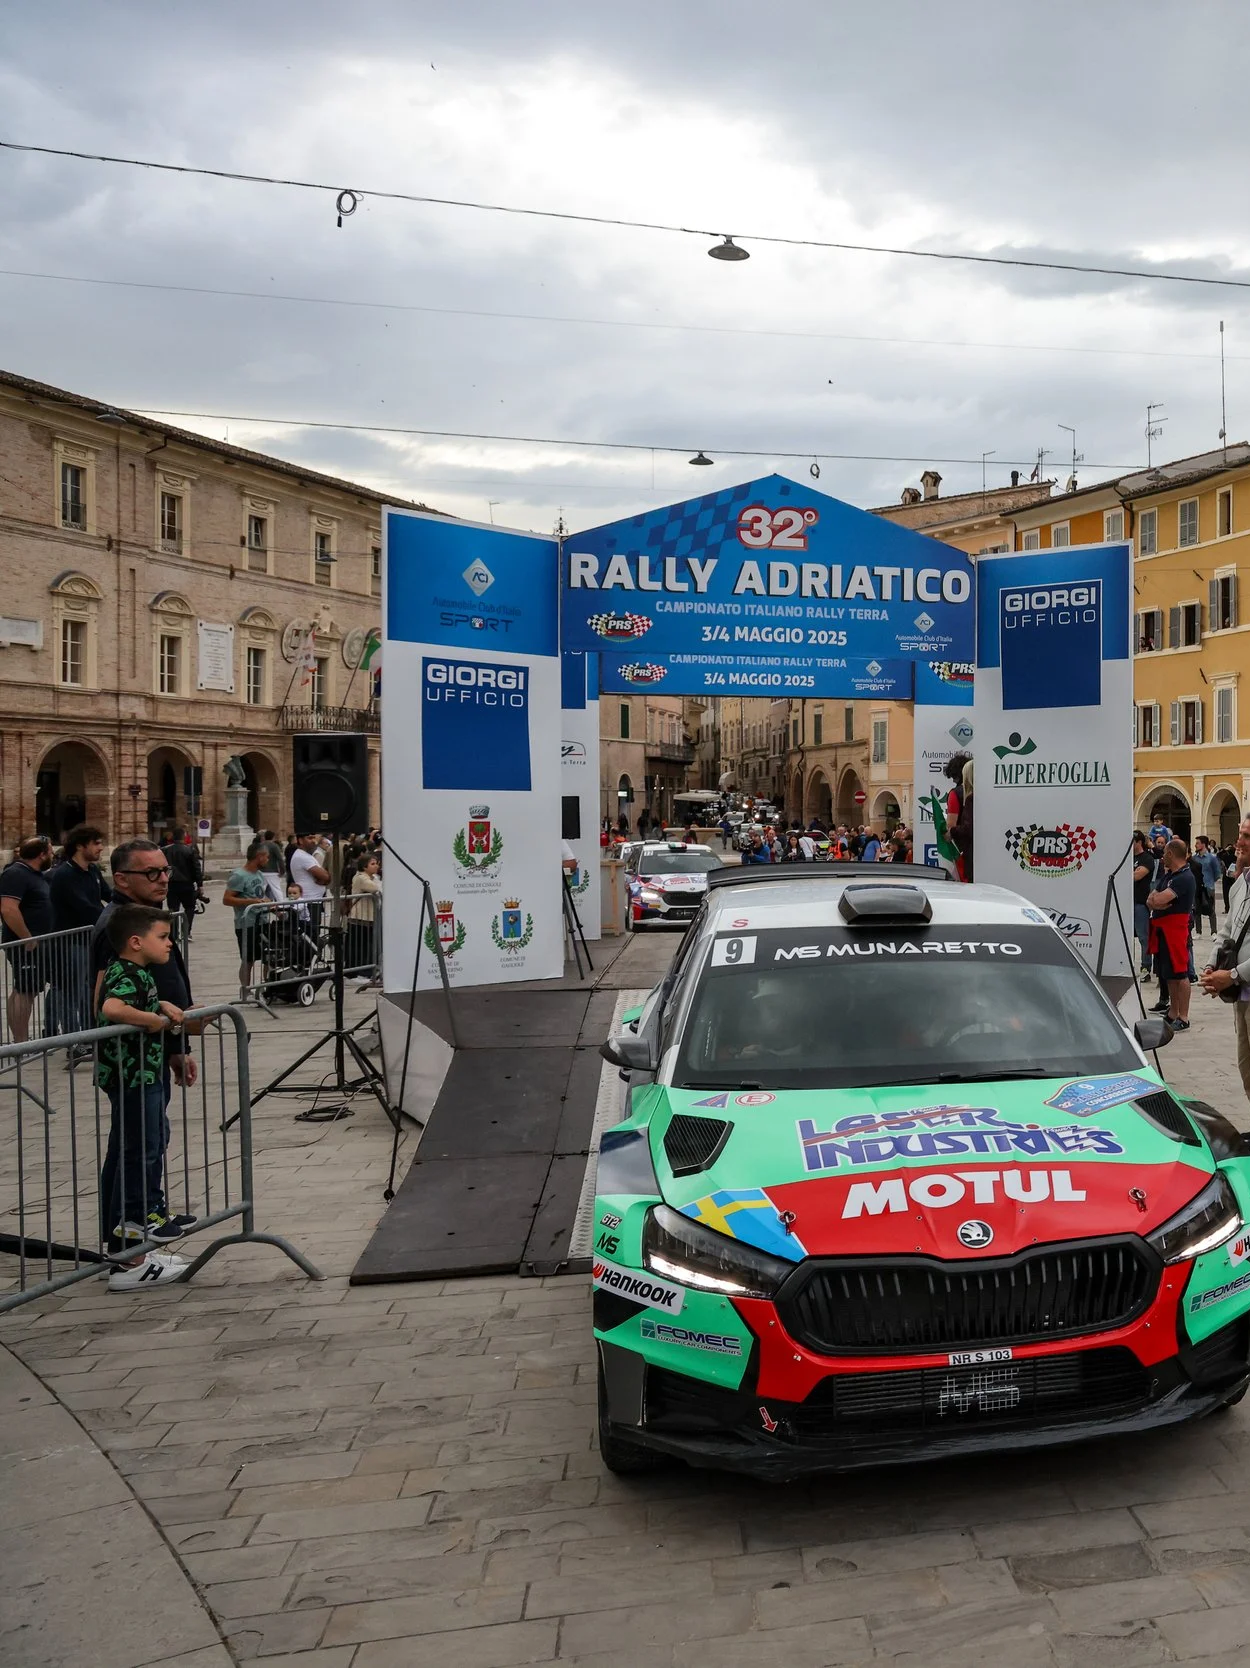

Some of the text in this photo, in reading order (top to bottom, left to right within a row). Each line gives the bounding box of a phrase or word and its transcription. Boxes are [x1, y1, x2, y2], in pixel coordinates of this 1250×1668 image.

[472, 571, 489, 584] ACI
[570, 552, 971, 604] RALLY ADRIATICO
[432, 596, 477, 611] Automobile
[478, 601, 495, 613] Club
[1005, 587, 1096, 612] GIORGI
[655, 601, 889, 621] CAMPIONATO ITALIANO RALLY TERRA
[1005, 609, 1096, 629] UFFICIO
[440, 612, 514, 633] SPORT
[607, 620, 632, 630] PRS
[701, 625, 848, 646] 3/4 MAGGIO 2025
[936, 635, 953, 643] d'Italia
[900, 642, 948, 652] SPORT
[669, 653, 847, 668] CAMPIONATO ITALIANO RALLY TERRA
[951, 663, 975, 674] PRS
[426, 663, 524, 690] GIORGI
[633, 668, 652, 677] PRS
[704, 672, 815, 688] 3/4 MAGGIO 2025
[855, 683, 892, 691] SPORT
[426, 687, 524, 708] UFFICIO
[994, 761, 1111, 785] IMPERFOGLIA
[1032, 836, 1069, 854] PRS
[1029, 856, 1071, 868] Group
[731, 918, 749, 929] S
[724, 939, 744, 964] 9
[774, 941, 1022, 961] MS MUNARETTO
[1075, 941, 1092, 949] Terra
[841, 1170, 1086, 1219] MOTUL
[596, 1232, 621, 1255] MS
[656, 1324, 740, 1350] FOMEC
[952, 1350, 1010, 1365] NR S 103
